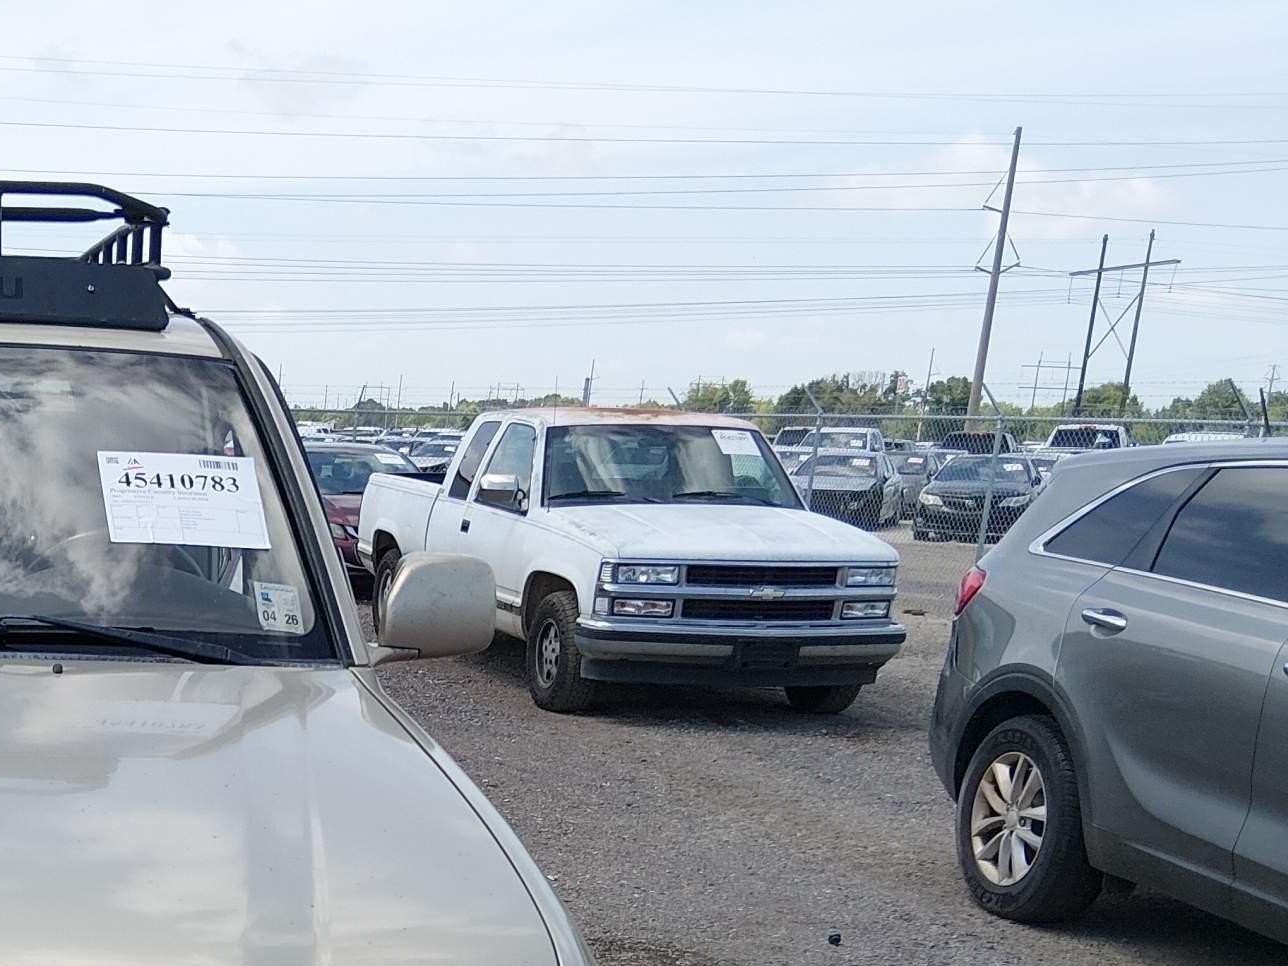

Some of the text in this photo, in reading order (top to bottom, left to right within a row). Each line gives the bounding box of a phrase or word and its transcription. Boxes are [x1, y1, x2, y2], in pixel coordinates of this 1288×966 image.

[118, 471, 240, 493] 45410783
[262, 609, 299, 626] 04 26
